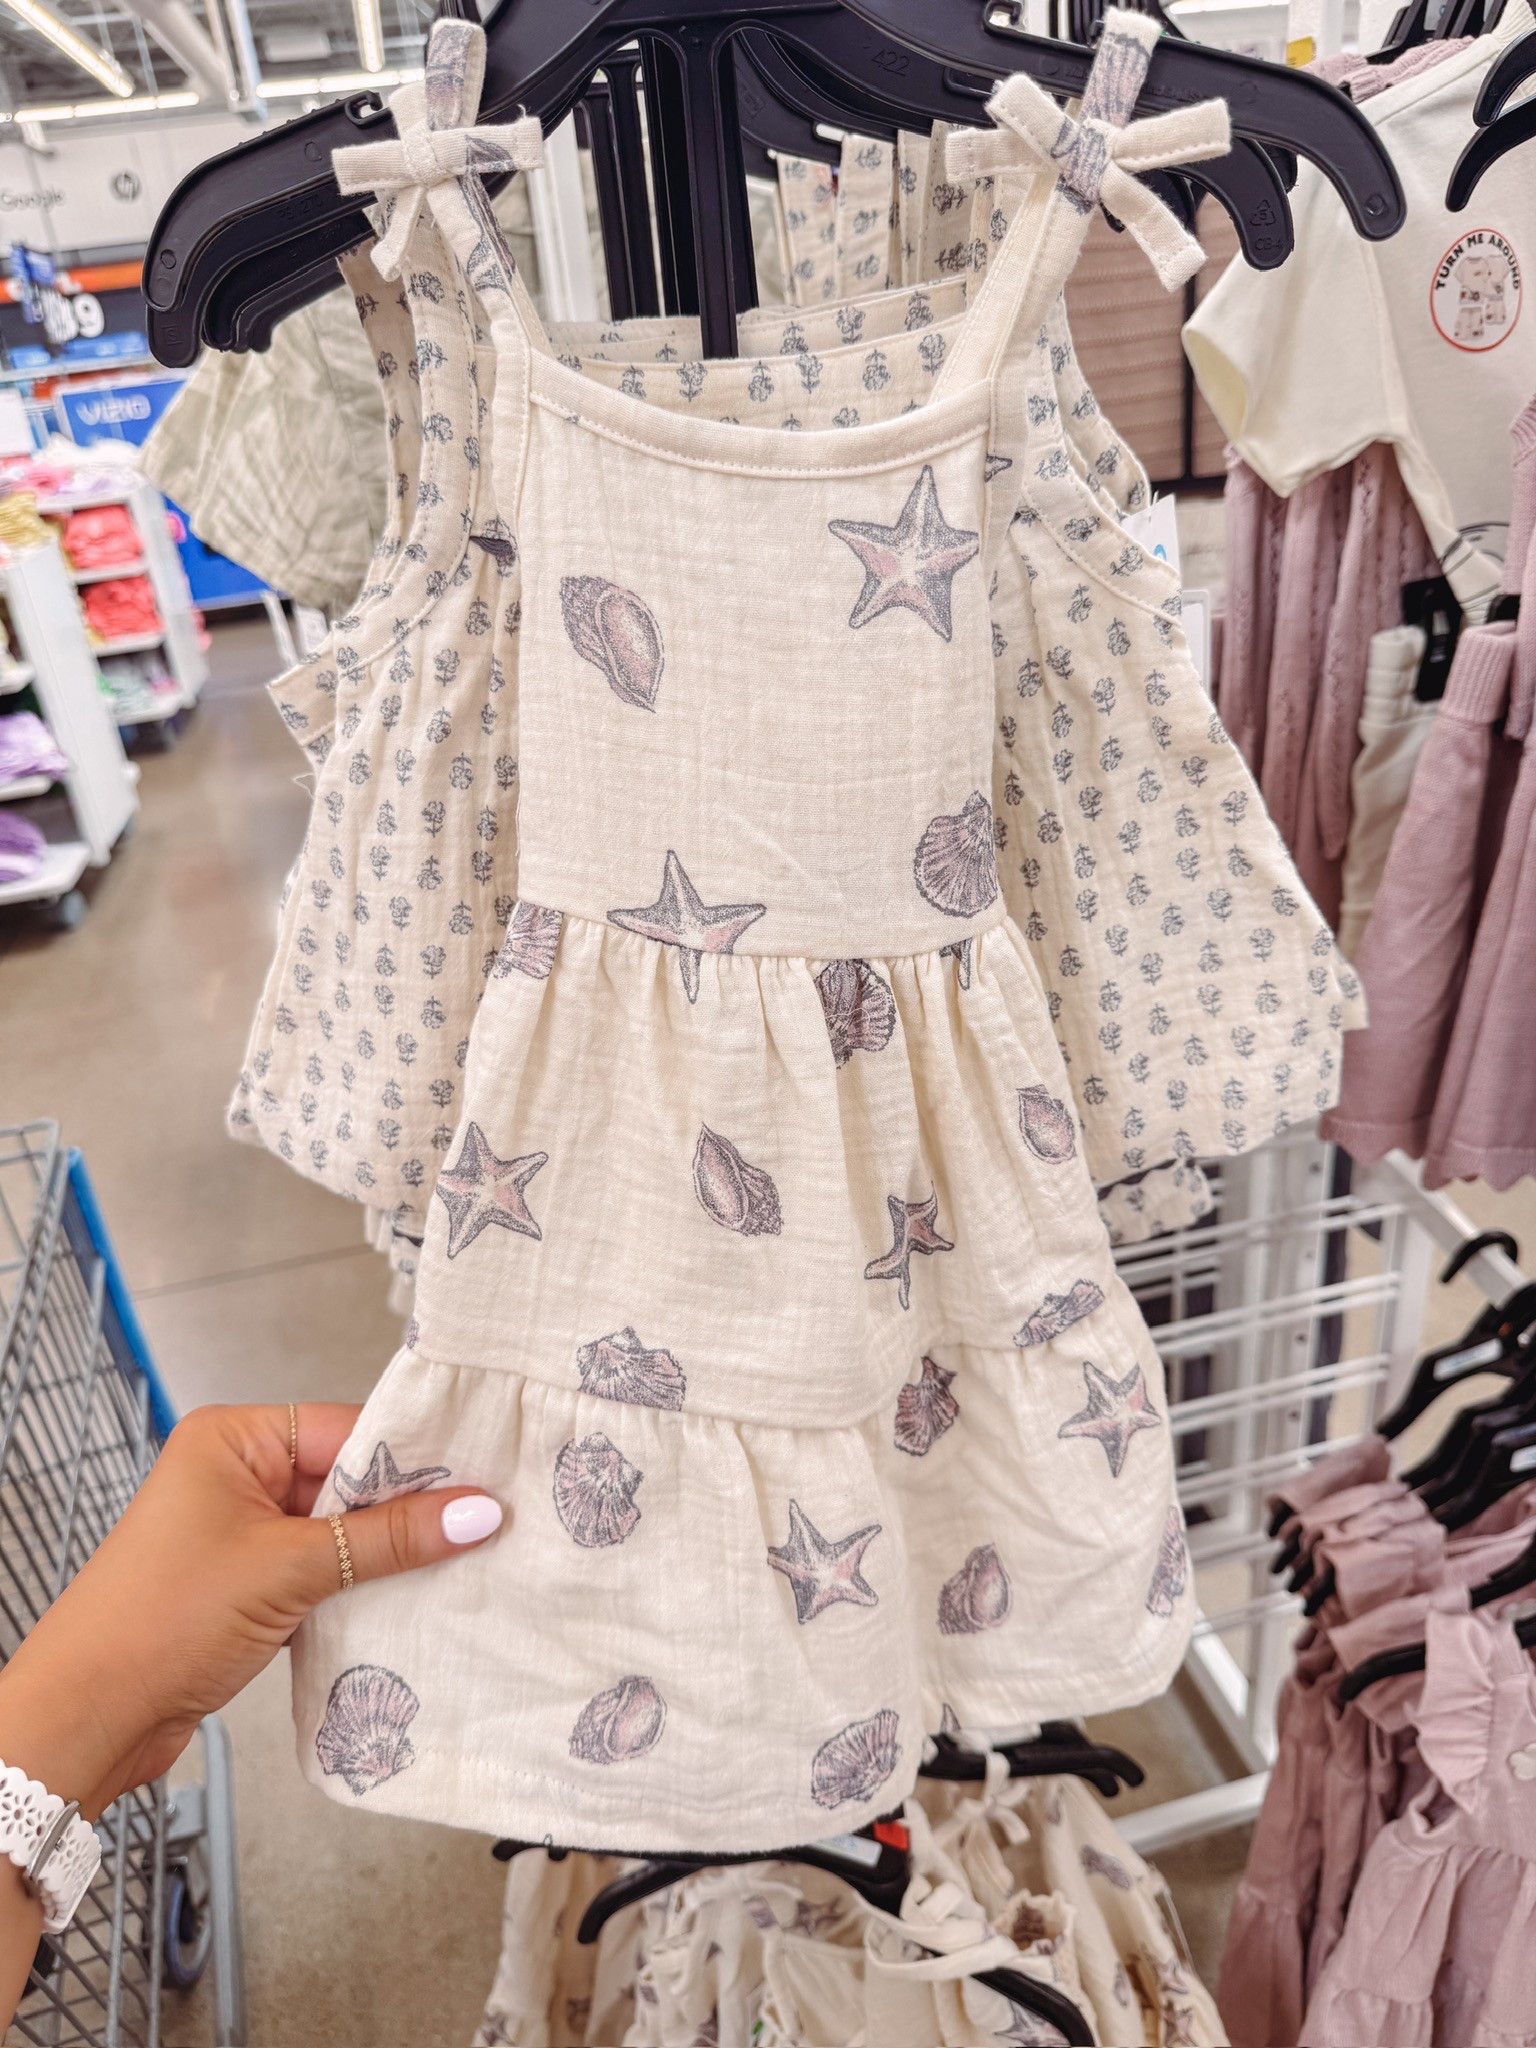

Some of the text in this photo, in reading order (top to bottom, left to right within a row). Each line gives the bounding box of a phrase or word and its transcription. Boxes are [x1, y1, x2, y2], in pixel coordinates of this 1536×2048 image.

[871, 50, 910, 77] 422
[1435, 233, 1520, 290] TURN ME AROUND
